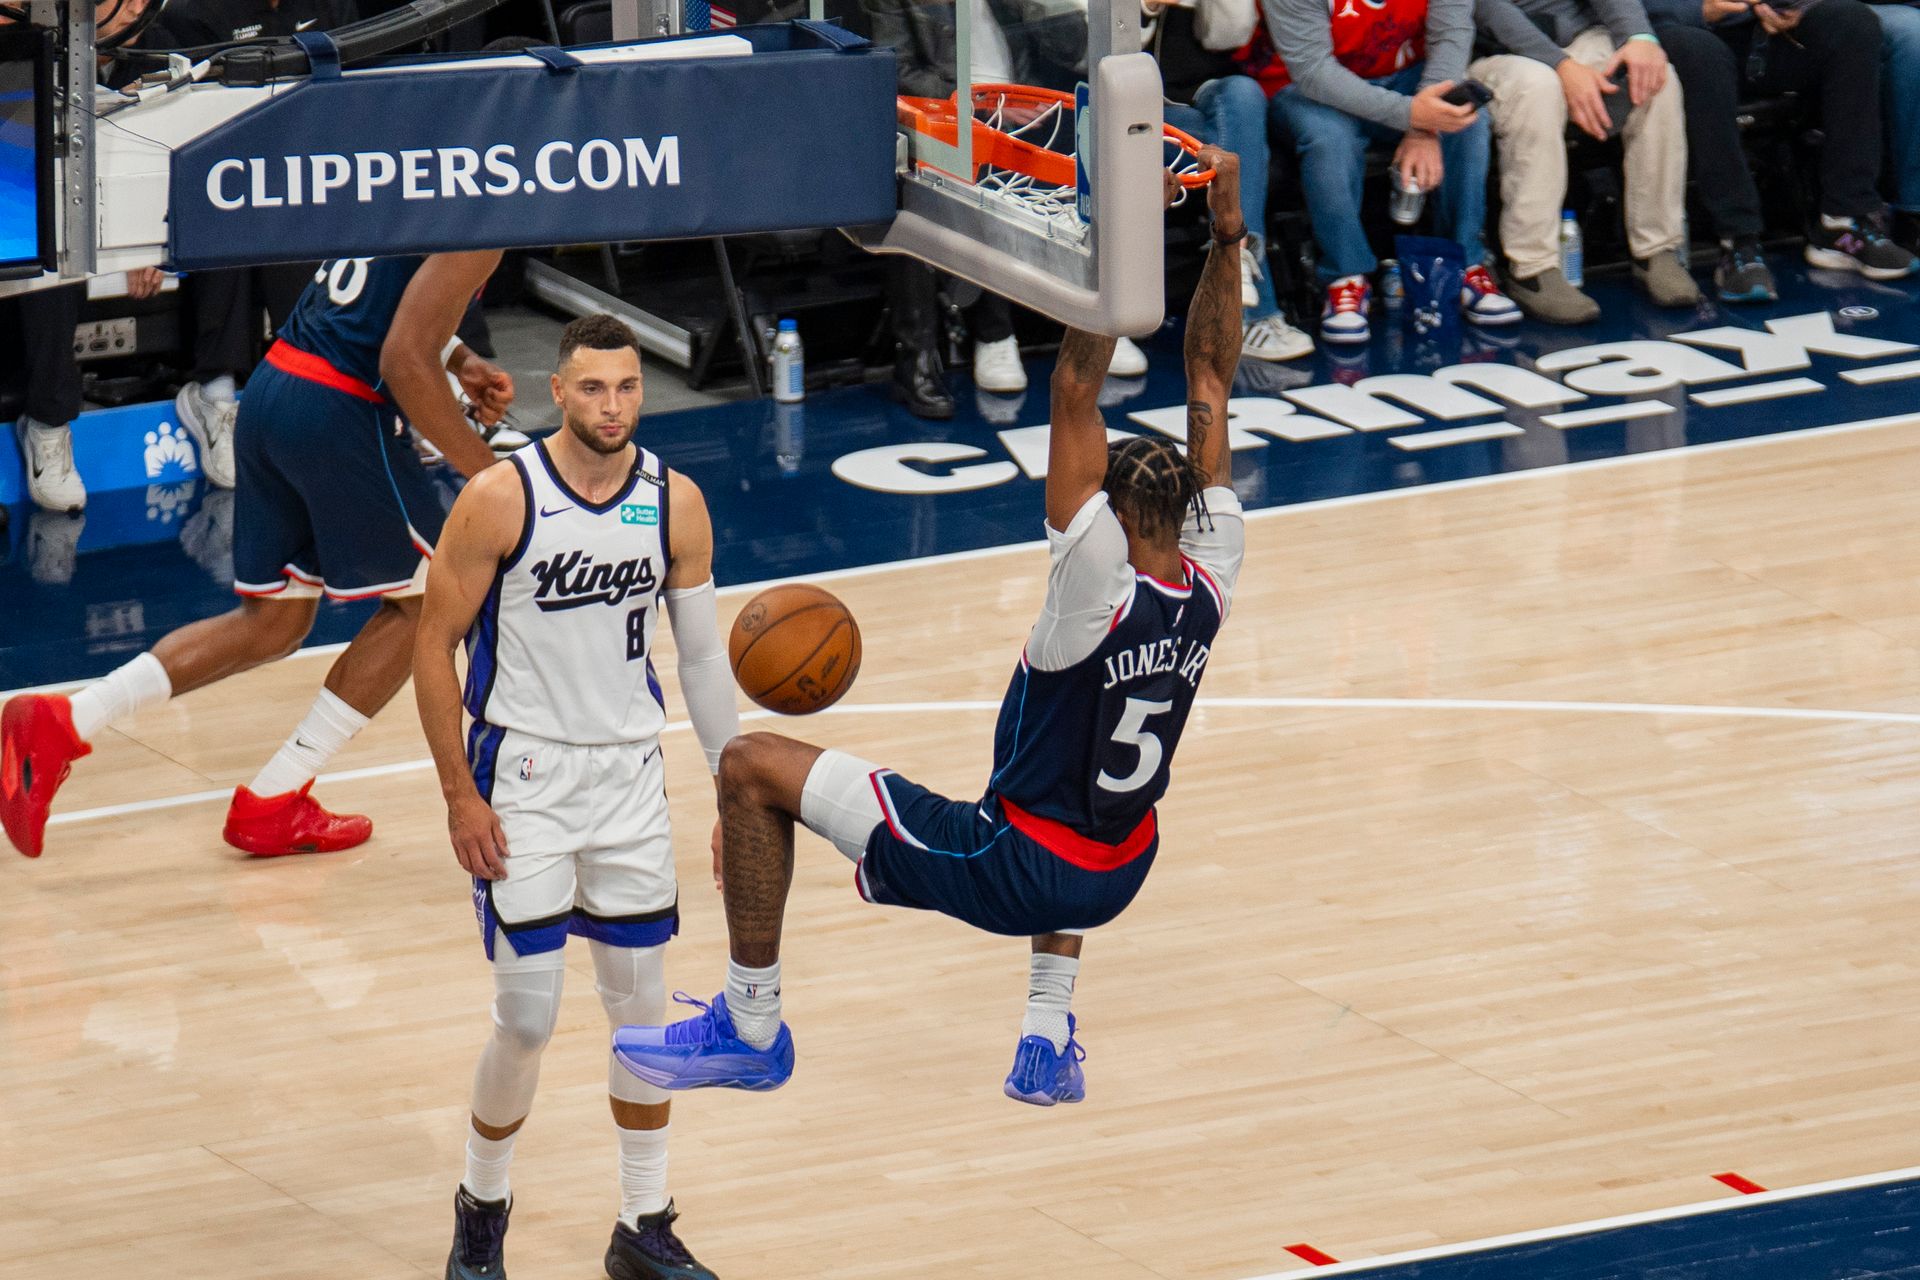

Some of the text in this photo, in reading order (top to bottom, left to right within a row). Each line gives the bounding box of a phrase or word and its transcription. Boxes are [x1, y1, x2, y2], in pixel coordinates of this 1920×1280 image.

[205, 135, 680, 210] CLIPPERS.COM
[1080, 193, 1091, 216] NB
[314, 256, 376, 306] 0
[530, 550, 656, 612] Kings
[626, 606, 648, 662] 8
[1104, 637, 1181, 689] JONES
[1096, 696, 1173, 792] 5
